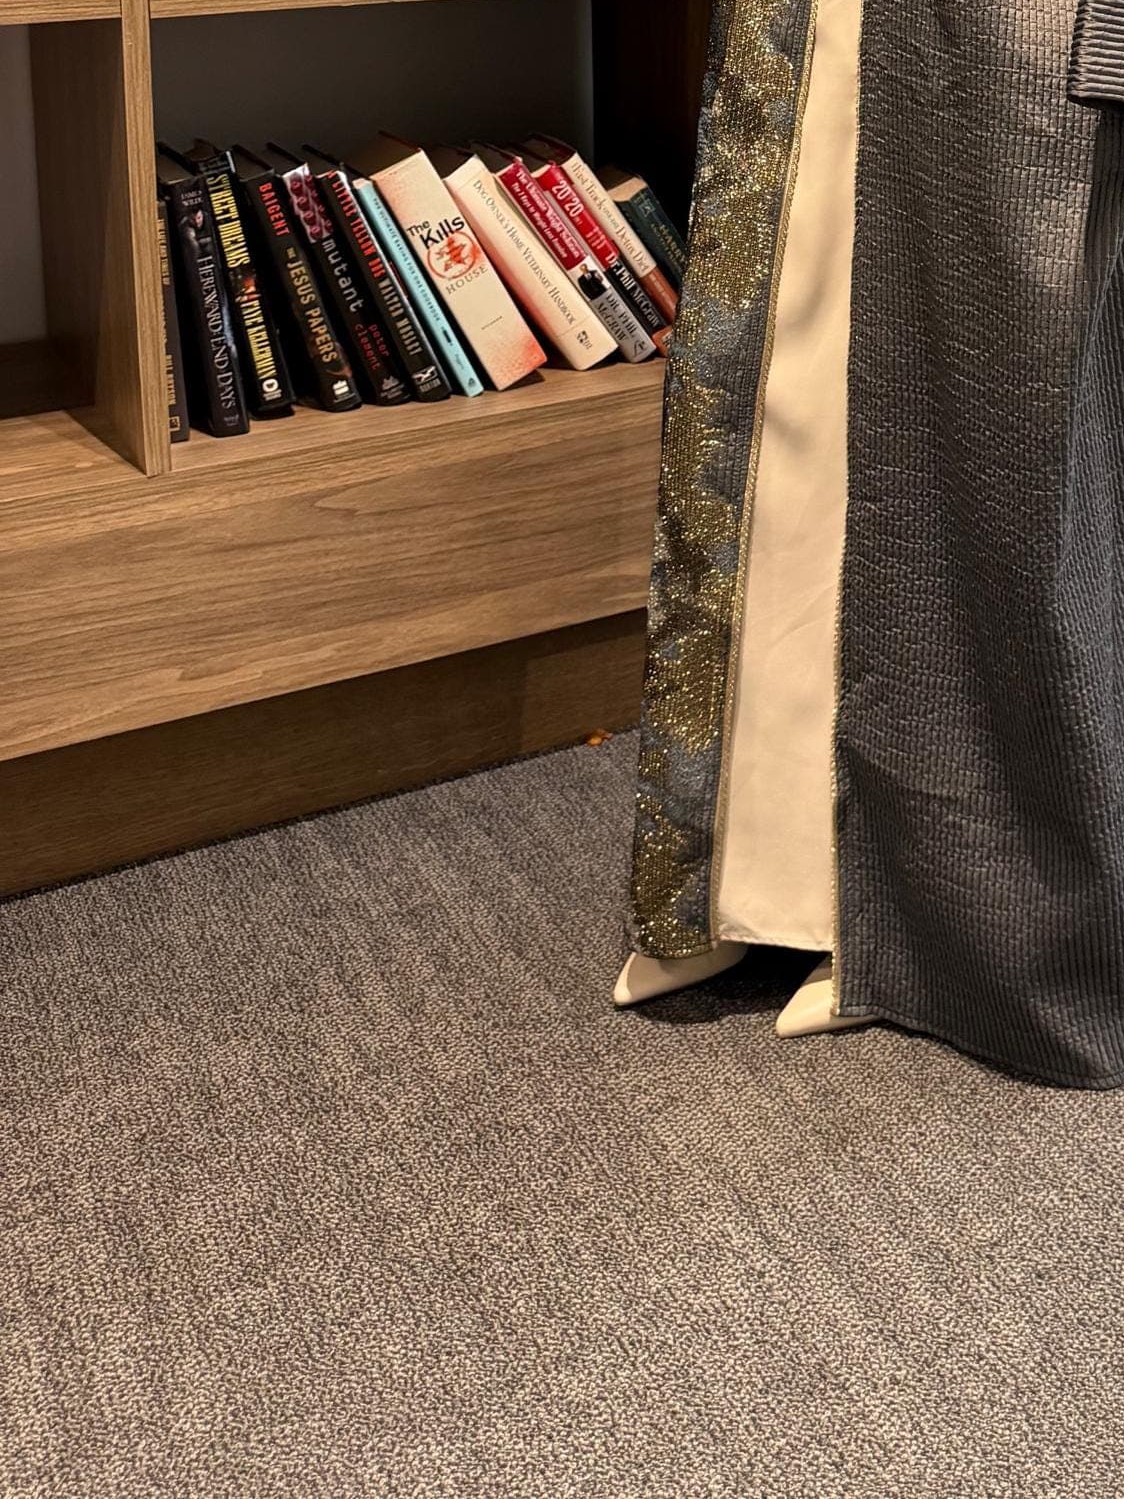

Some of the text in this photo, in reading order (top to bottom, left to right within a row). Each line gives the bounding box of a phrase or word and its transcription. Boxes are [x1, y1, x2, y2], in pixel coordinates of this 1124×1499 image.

[205, 172, 251, 268] STREET DREAMS
[258, 181, 290, 237] BAIGENT
[406, 220, 431, 239] The
[420, 215, 466, 250] Kills
[515, 168, 584, 259] The Ultimate Weight Solution
[582, 181, 652, 273] Track Detox Diet
[319, 237, 366, 313] mutant
[330, 178, 423, 357] LITTLE YELLOW DOG WALTER MOSLEY
[446, 265, 489, 295] HOUSE
[285, 258, 338, 363] JESUS PAPERS
[595, 300, 630, 344] McGRAW
[616, 309, 641, 338] PHIL
[628, 286, 664, 329] McGraw
[239, 299, 277, 380] FAYE KELLERMAN
[350, 321, 383, 371] clement
[365, 322, 392, 360] peter
[209, 334, 238, 409] END DAYS
